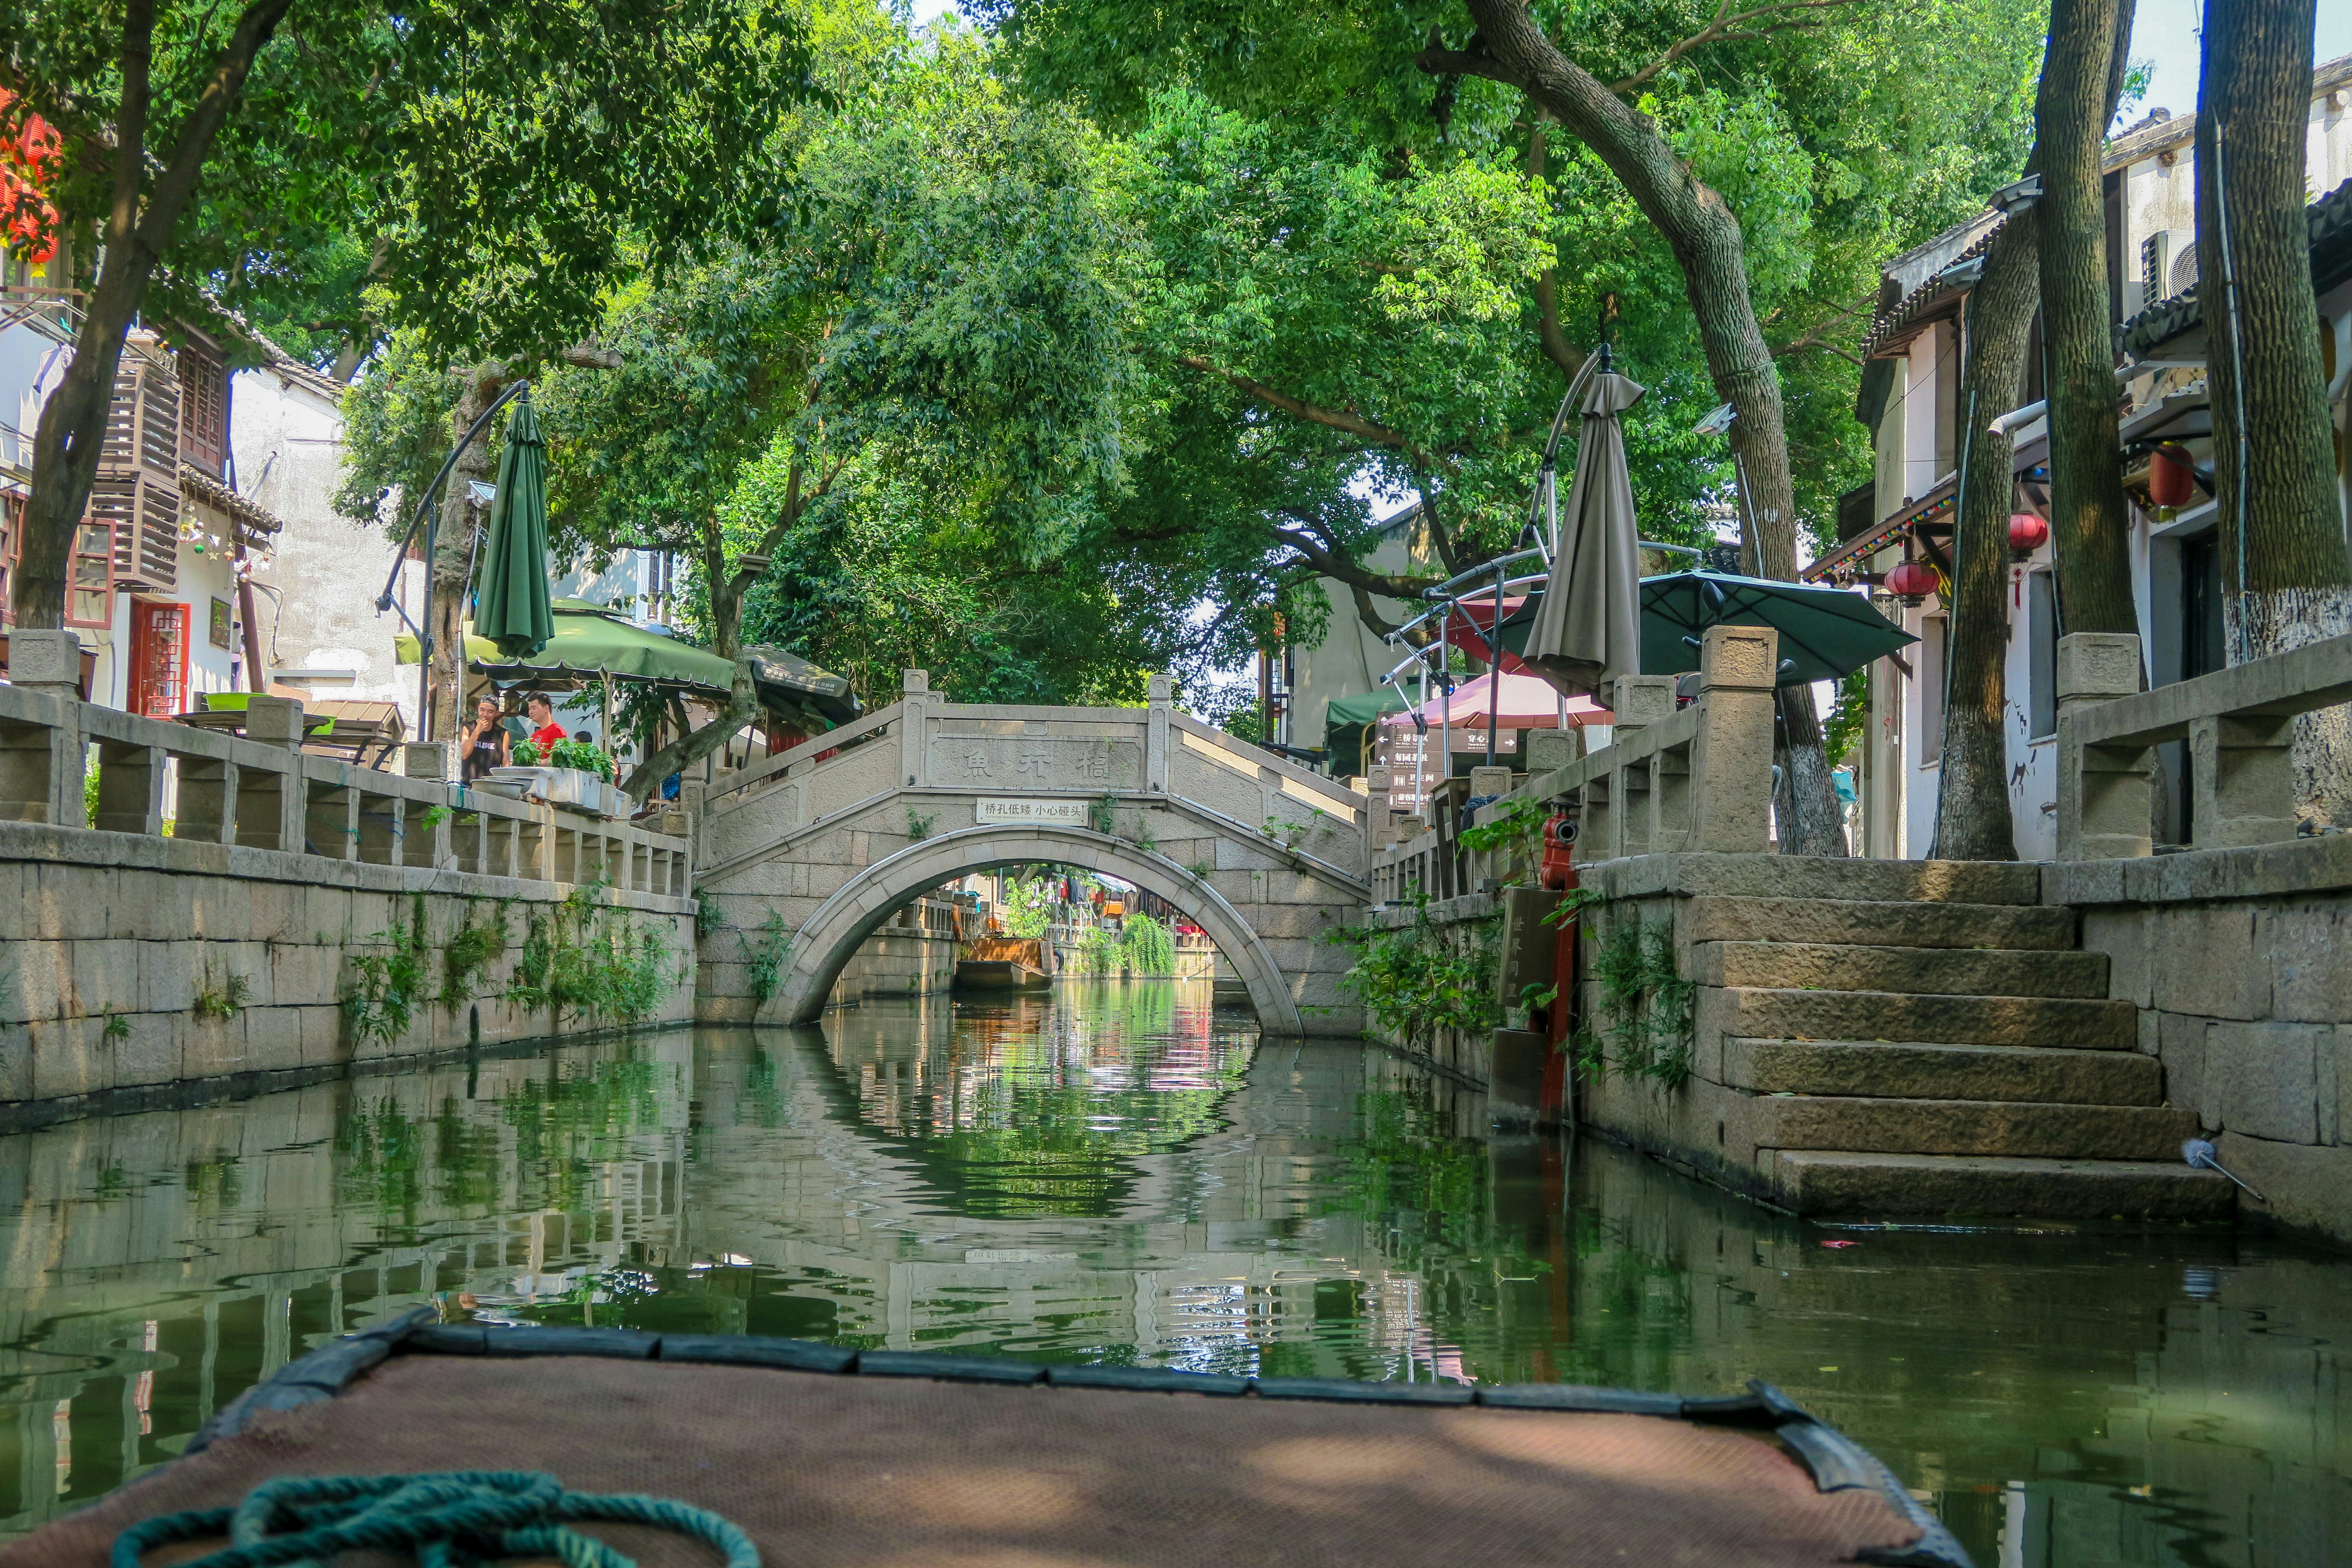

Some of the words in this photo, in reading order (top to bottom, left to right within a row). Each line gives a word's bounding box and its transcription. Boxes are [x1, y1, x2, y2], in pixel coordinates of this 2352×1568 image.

[774, 671, 835, 688] 0512-63337888
[985, 802, 1031, 815] 桥孔低矮
[1035, 805, 1081, 817] 小心碰头
[1506, 916, 1524, 998] 世界同里
